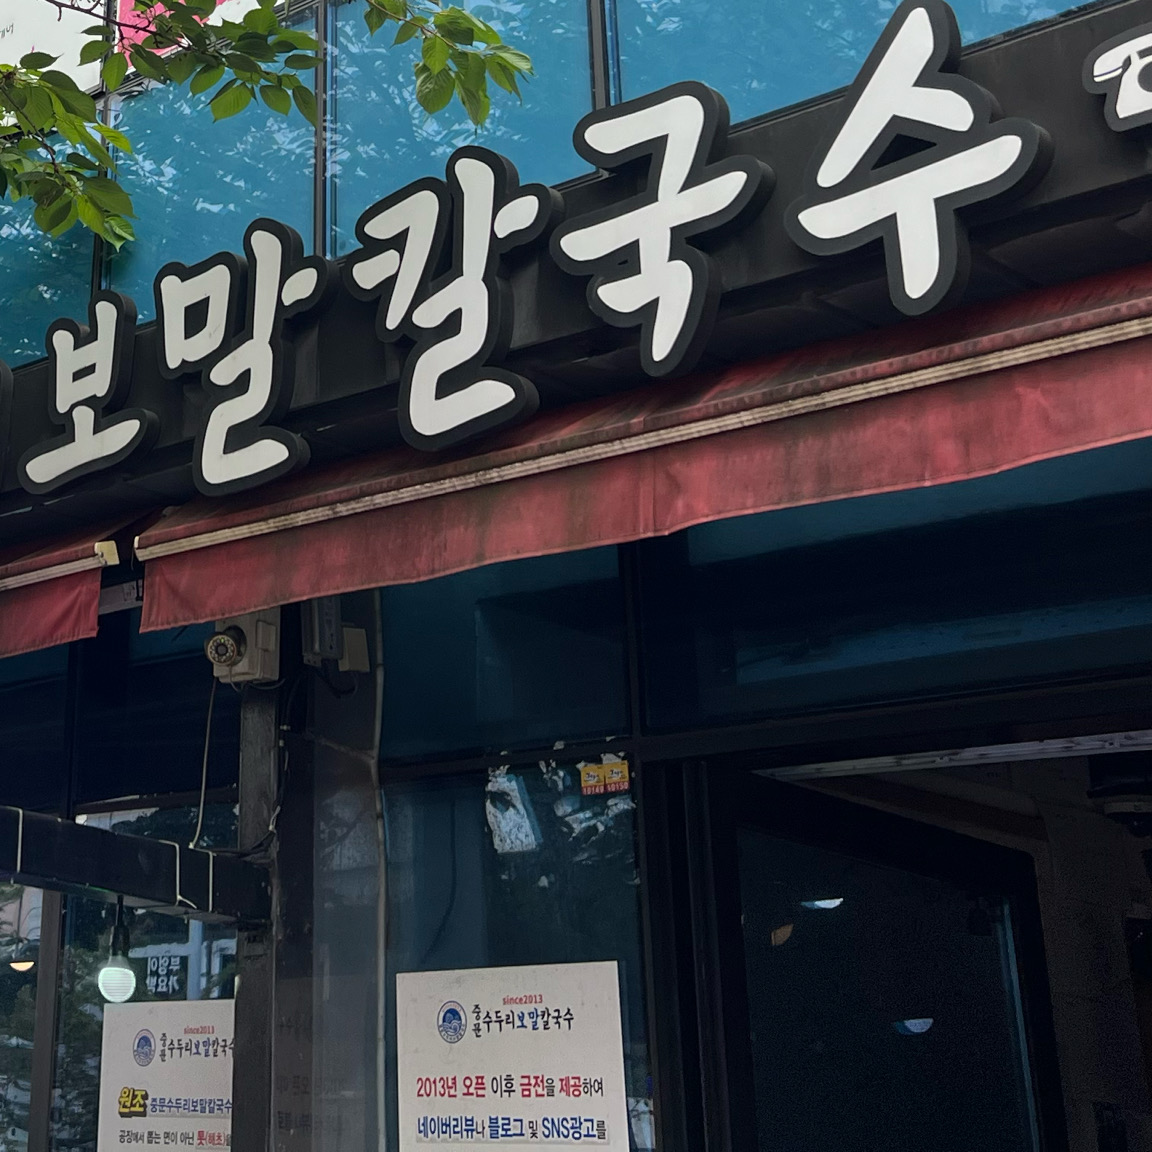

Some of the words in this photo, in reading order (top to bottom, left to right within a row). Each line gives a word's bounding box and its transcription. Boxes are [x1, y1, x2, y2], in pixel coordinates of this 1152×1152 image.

[503, 994, 543, 1005] since2013
[416, 1075, 458, 1098] 2013년
[462, 1075, 486, 1098] 오픈
[491, 1074, 516, 1098] 이후
[519, 1074, 555, 1098] 금전을
[559, 1075, 604, 1098] 제공하여
[118, 1087, 149, 1118] 원조
[417, 1116, 485, 1139] 네이버리뷰나
[488, 1116, 524, 1139] 블로그
[528, 1120, 539, 1140] 및
[542, 1116, 607, 1140] SNS광고를
